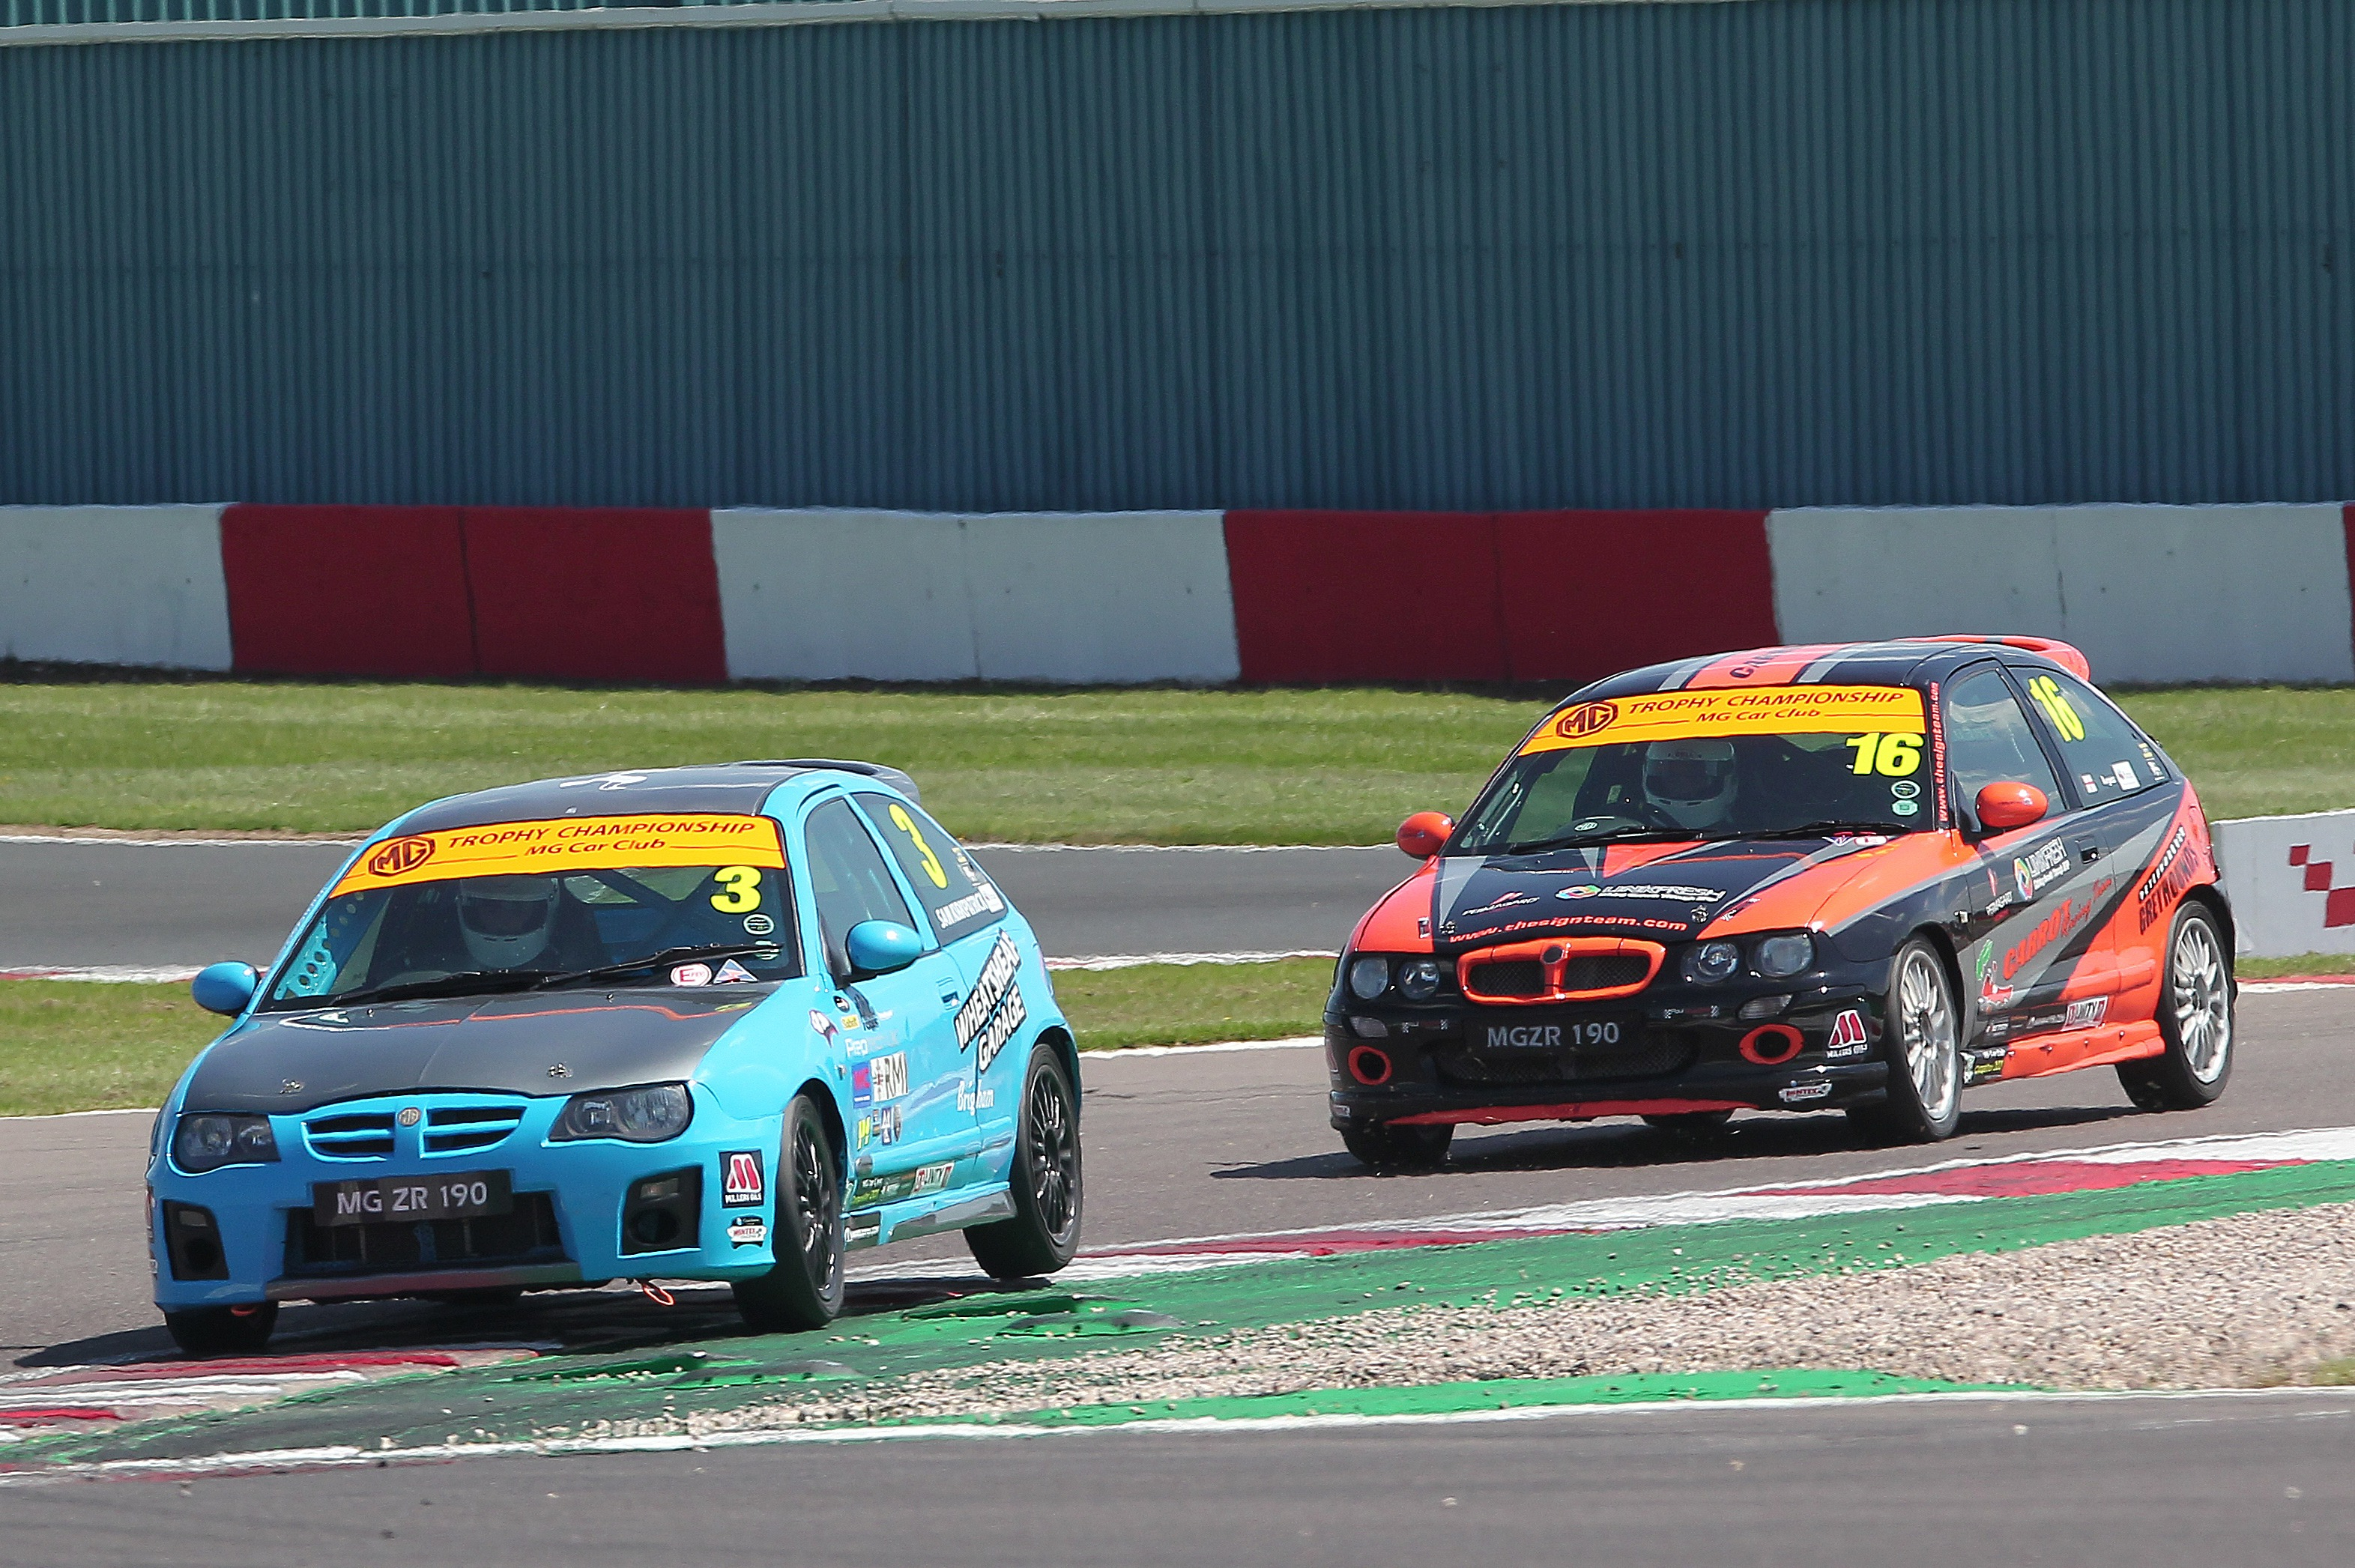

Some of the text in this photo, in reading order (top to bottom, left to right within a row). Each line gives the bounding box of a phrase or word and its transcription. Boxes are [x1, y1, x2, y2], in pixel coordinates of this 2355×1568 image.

[1564, 703, 1613, 734] MG
[1629, 691, 1904, 714] TROPHY CHAMPIONSHIP
[1696, 708, 1821, 723] MG Car Club
[2028, 674, 2086, 742] 16
[1845, 732, 1925, 777] 16
[449, 821, 755, 848] TROPHY CHAMPIONSHIP
[524, 838, 665, 856] MG Car Club
[888, 803, 949, 890] 3
[375, 838, 429, 872] MG
[710, 865, 762, 913] 3
[2002, 899, 2073, 980] CARROT
[955, 929, 1021, 1050] WHEATSHEAF
[978, 984, 1025, 1071] GARAGE
[1487, 1022, 1620, 1047] MGZR 190
[957, 1080, 994, 1116] Brigham
[337, 1181, 488, 1214] MG ZR 190
